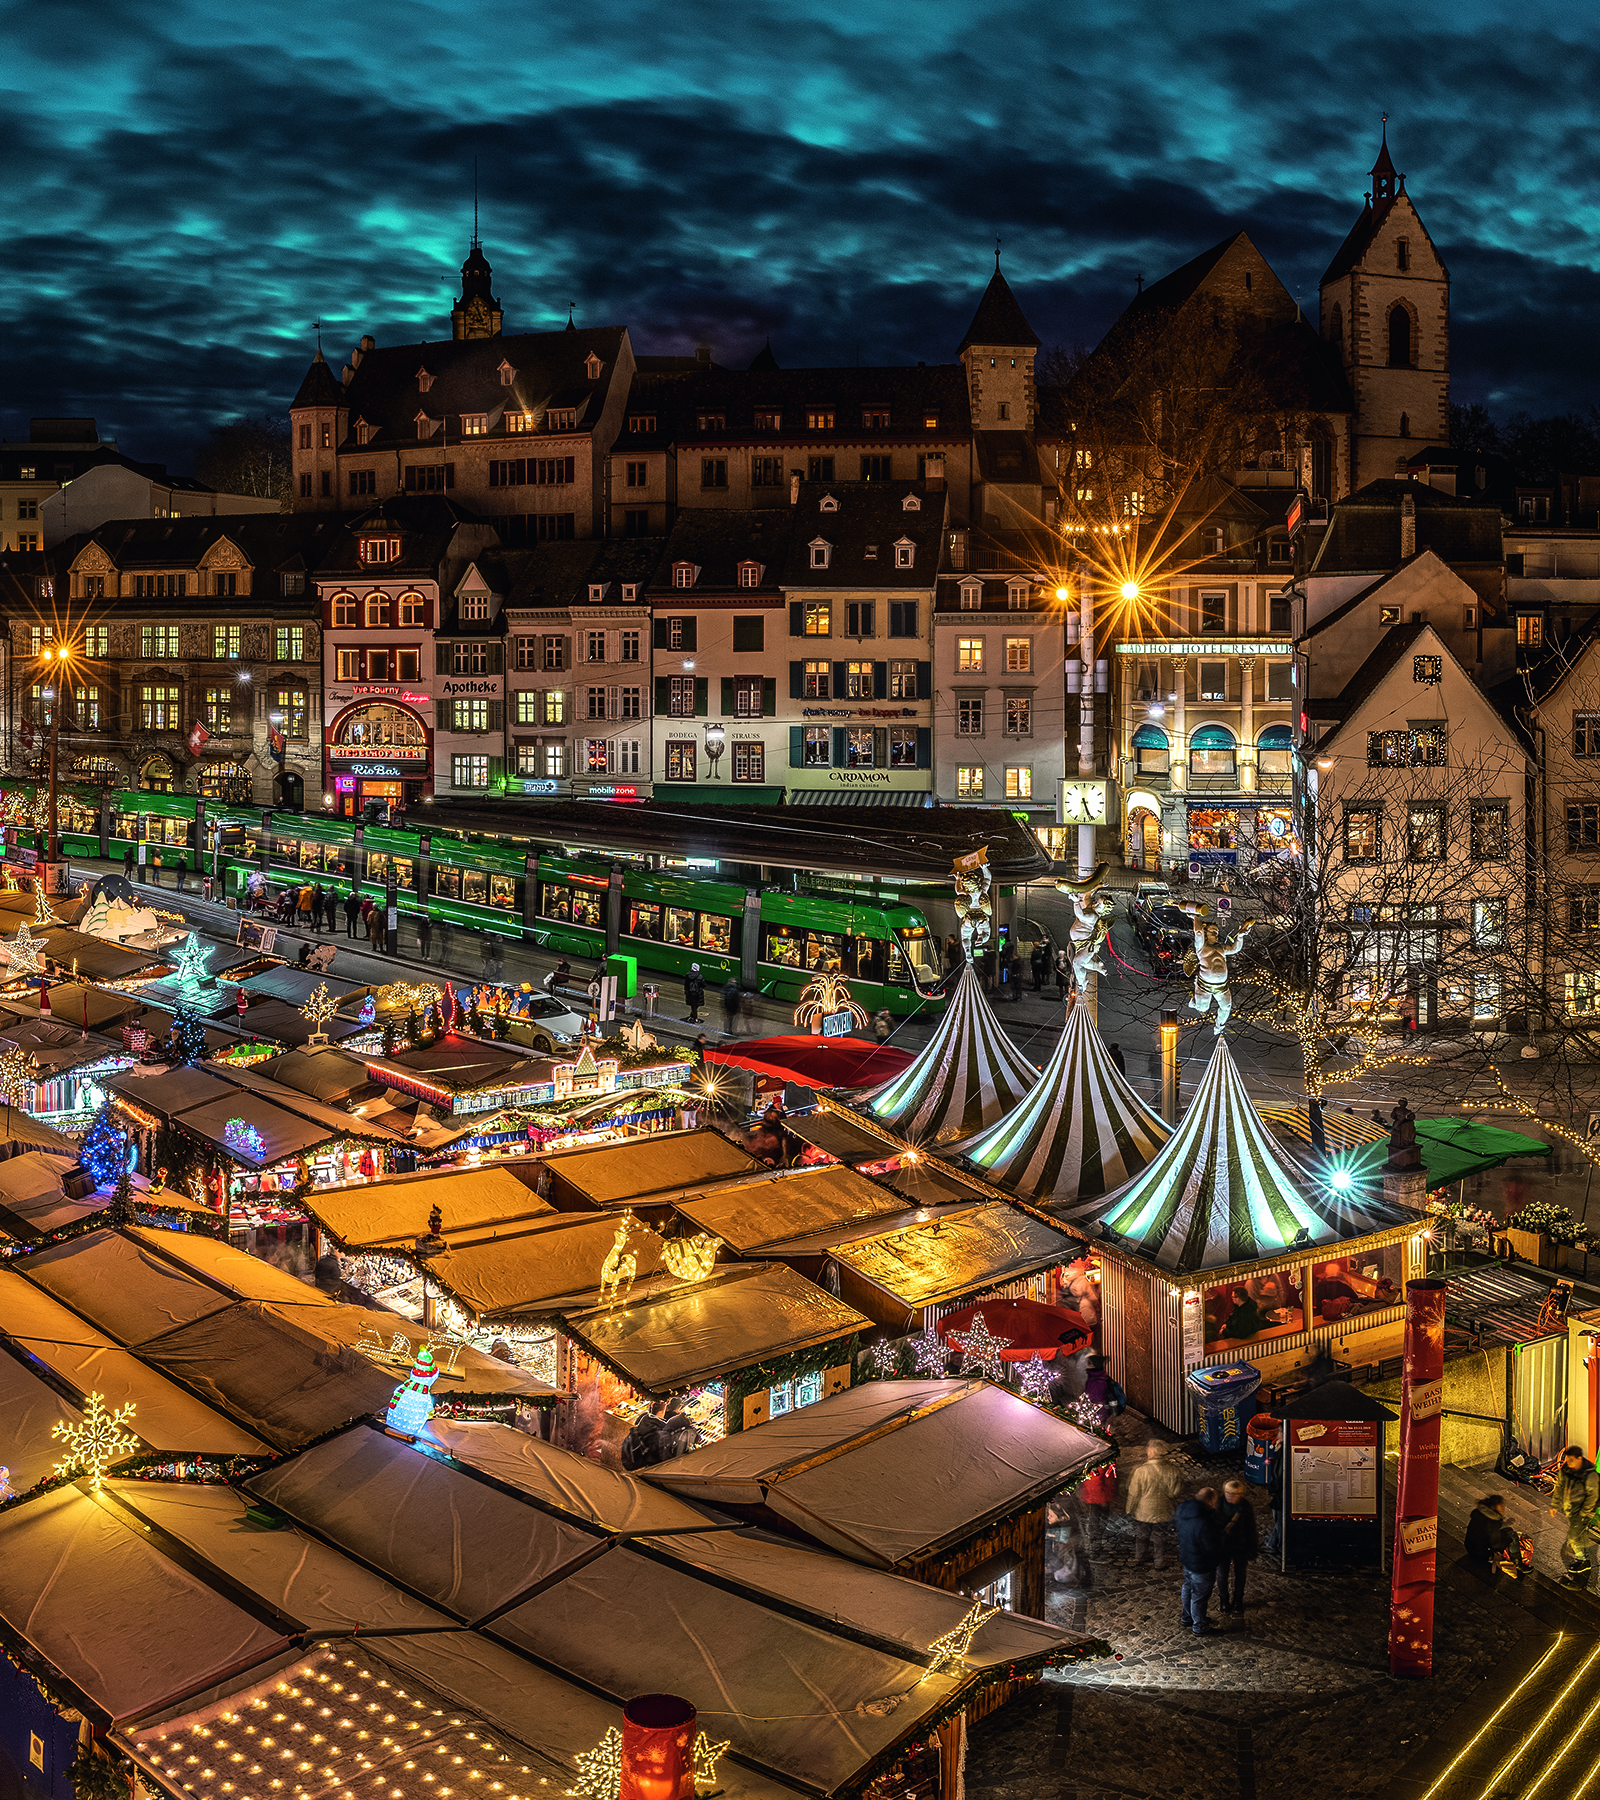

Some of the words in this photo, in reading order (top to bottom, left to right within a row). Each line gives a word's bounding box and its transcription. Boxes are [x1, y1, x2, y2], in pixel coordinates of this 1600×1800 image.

[1182, 644, 1226, 654] HOTEL
[369, 685, 400, 695] Fourny
[443, 680, 498, 696] Apotheke
[731, 732, 761, 740] STRAUSS
[335, 749, 392, 758] ZIEGELHOF
[393, 750, 420, 758] BIER
[828, 772, 891, 783] CARDAMOM
[588, 785, 636, 795] mobilezone
